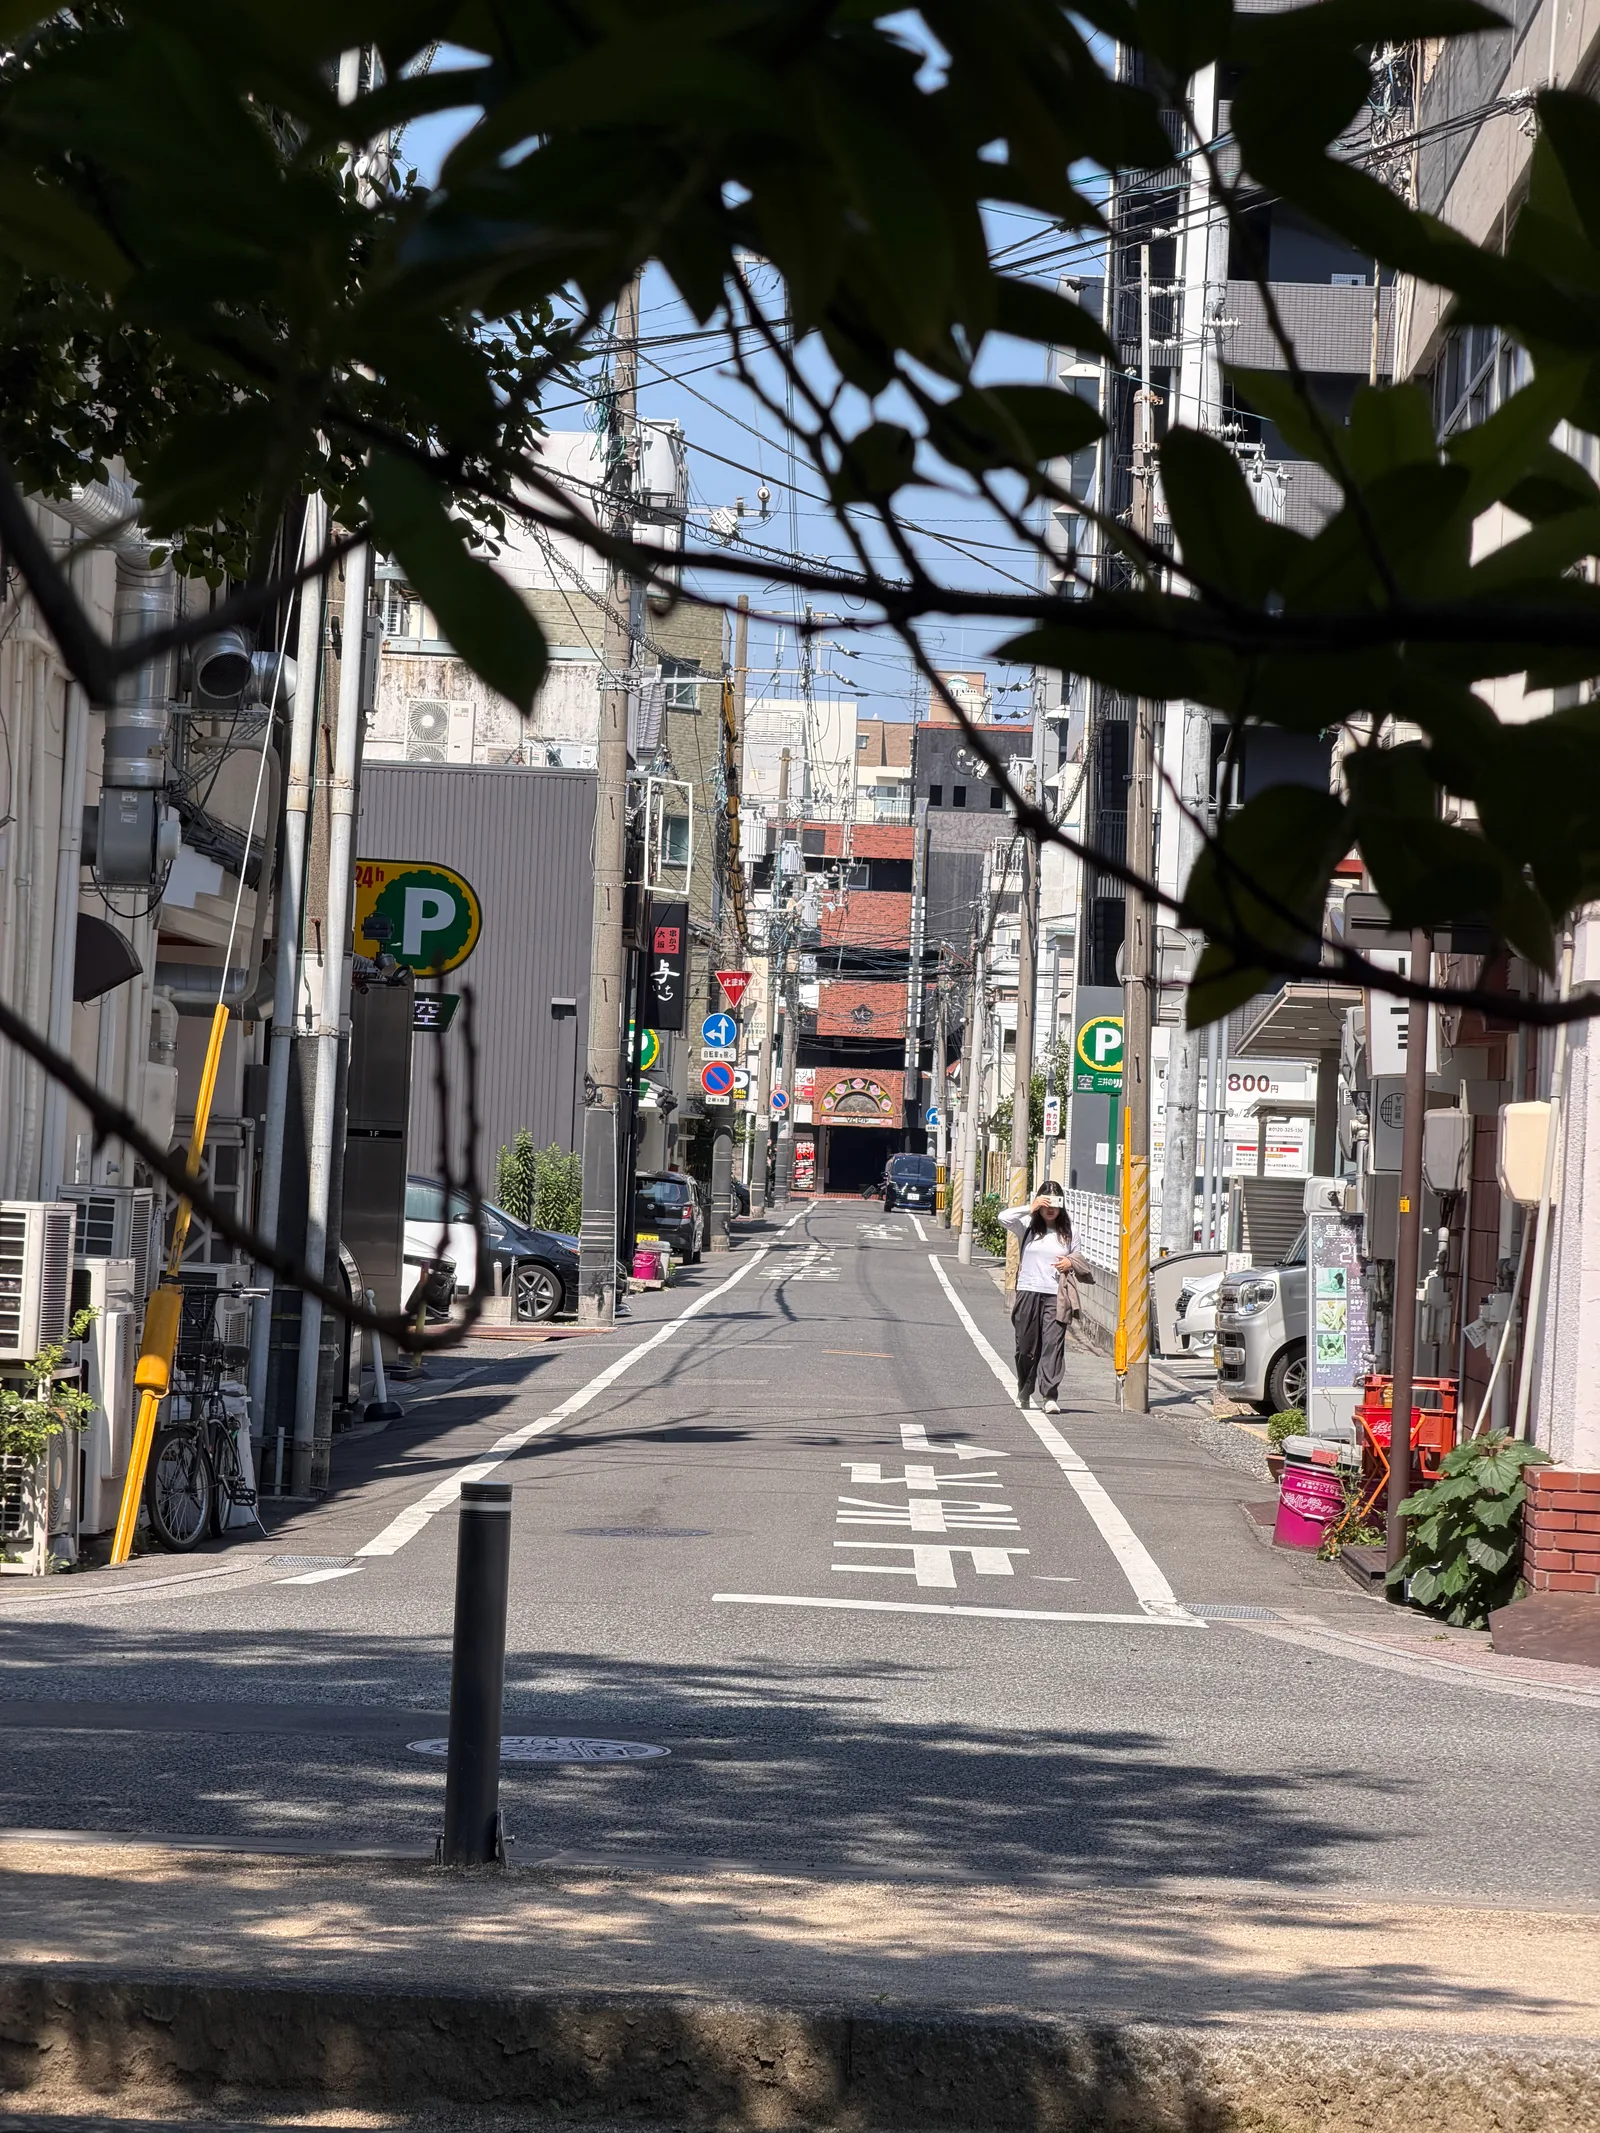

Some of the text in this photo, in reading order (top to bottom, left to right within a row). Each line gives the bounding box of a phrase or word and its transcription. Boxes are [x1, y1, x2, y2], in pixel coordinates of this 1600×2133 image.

[402, 887, 456, 955] P
[668, 929, 677, 951] 串かつ
[723, 977, 747, 987] 止まれ
[413, 997, 442, 1026] 空
[1095, 1027, 1122, 1062] P
